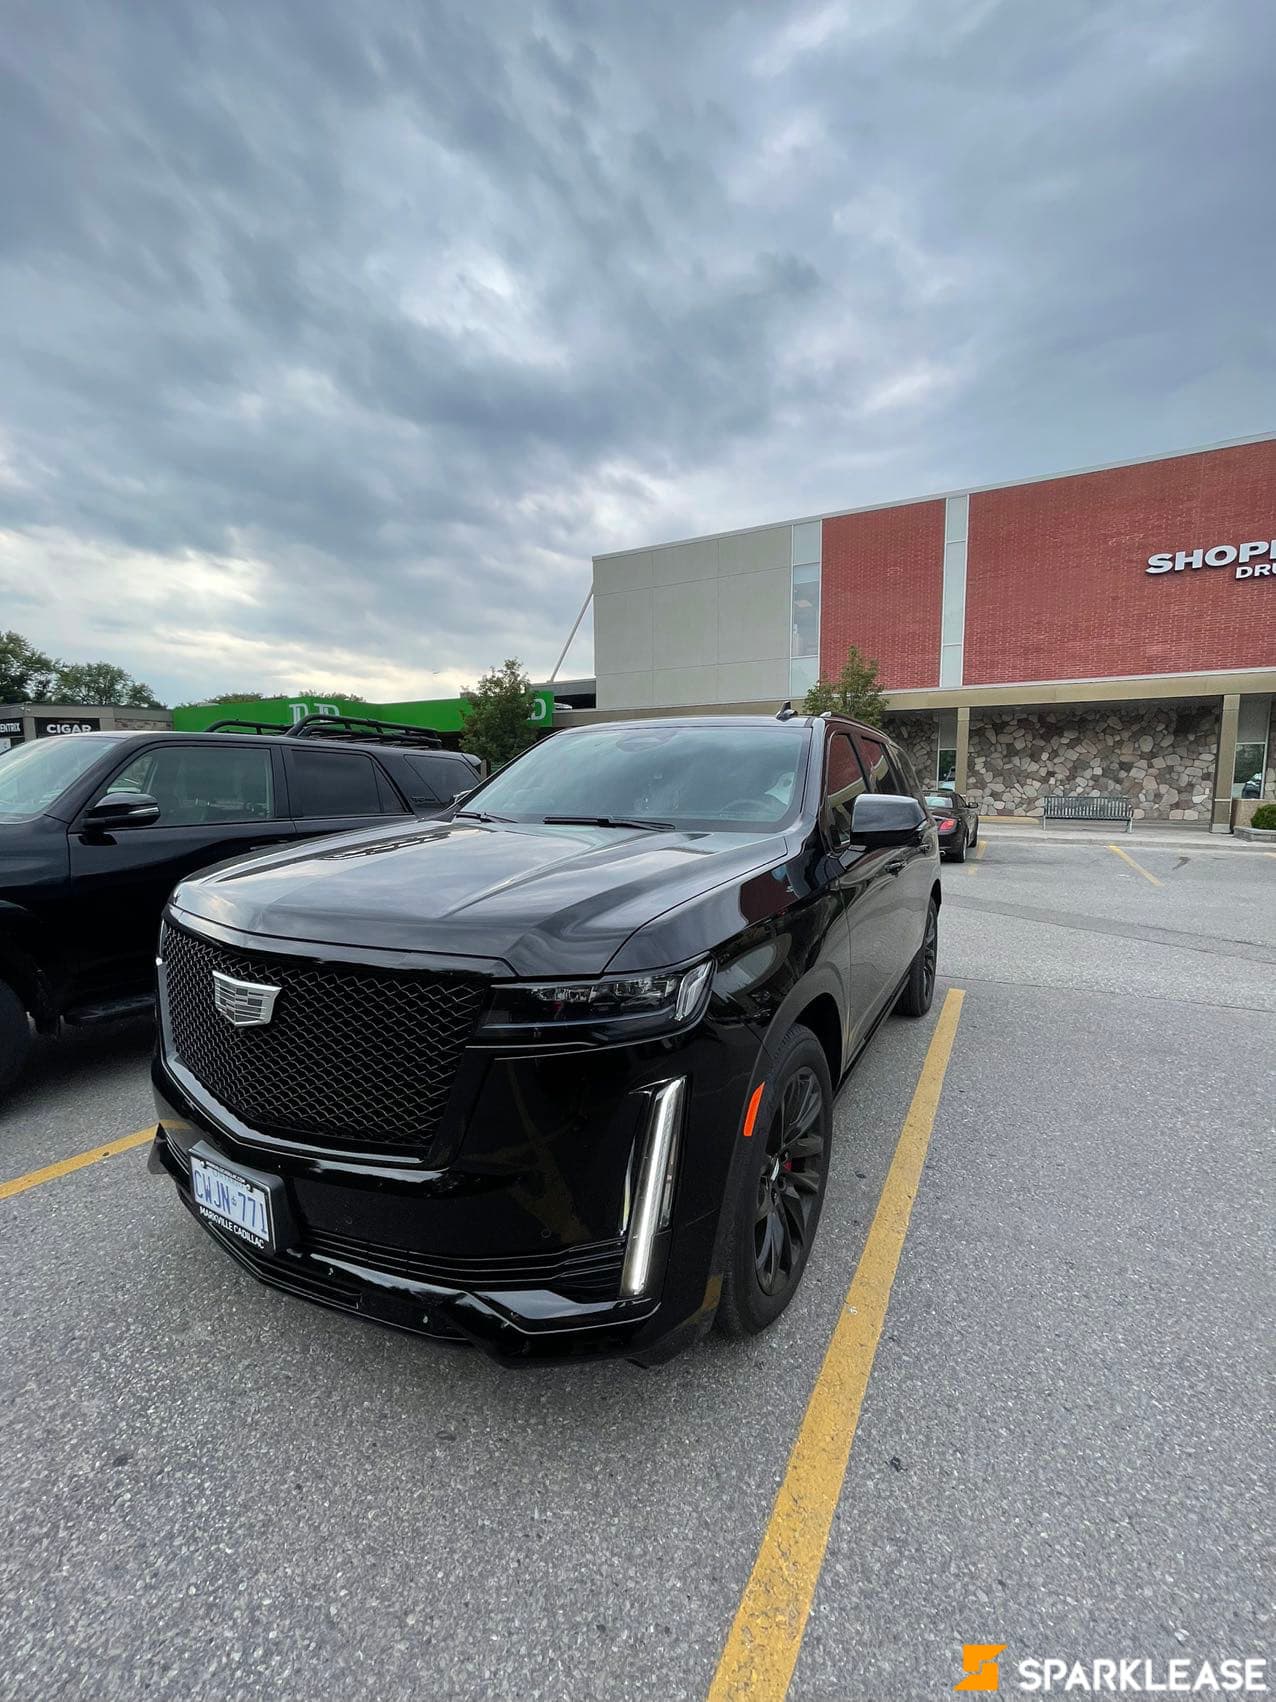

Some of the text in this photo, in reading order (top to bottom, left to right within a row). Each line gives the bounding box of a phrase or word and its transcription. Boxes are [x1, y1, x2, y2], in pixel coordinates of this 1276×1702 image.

[1145, 539, 1276, 574] SHOP
[1235, 562, 1276, 579] DR
[46, 724, 92, 734] CIGAR
[194, 1169, 231, 1215] CWJN
[237, 1191, 268, 1235] 771
